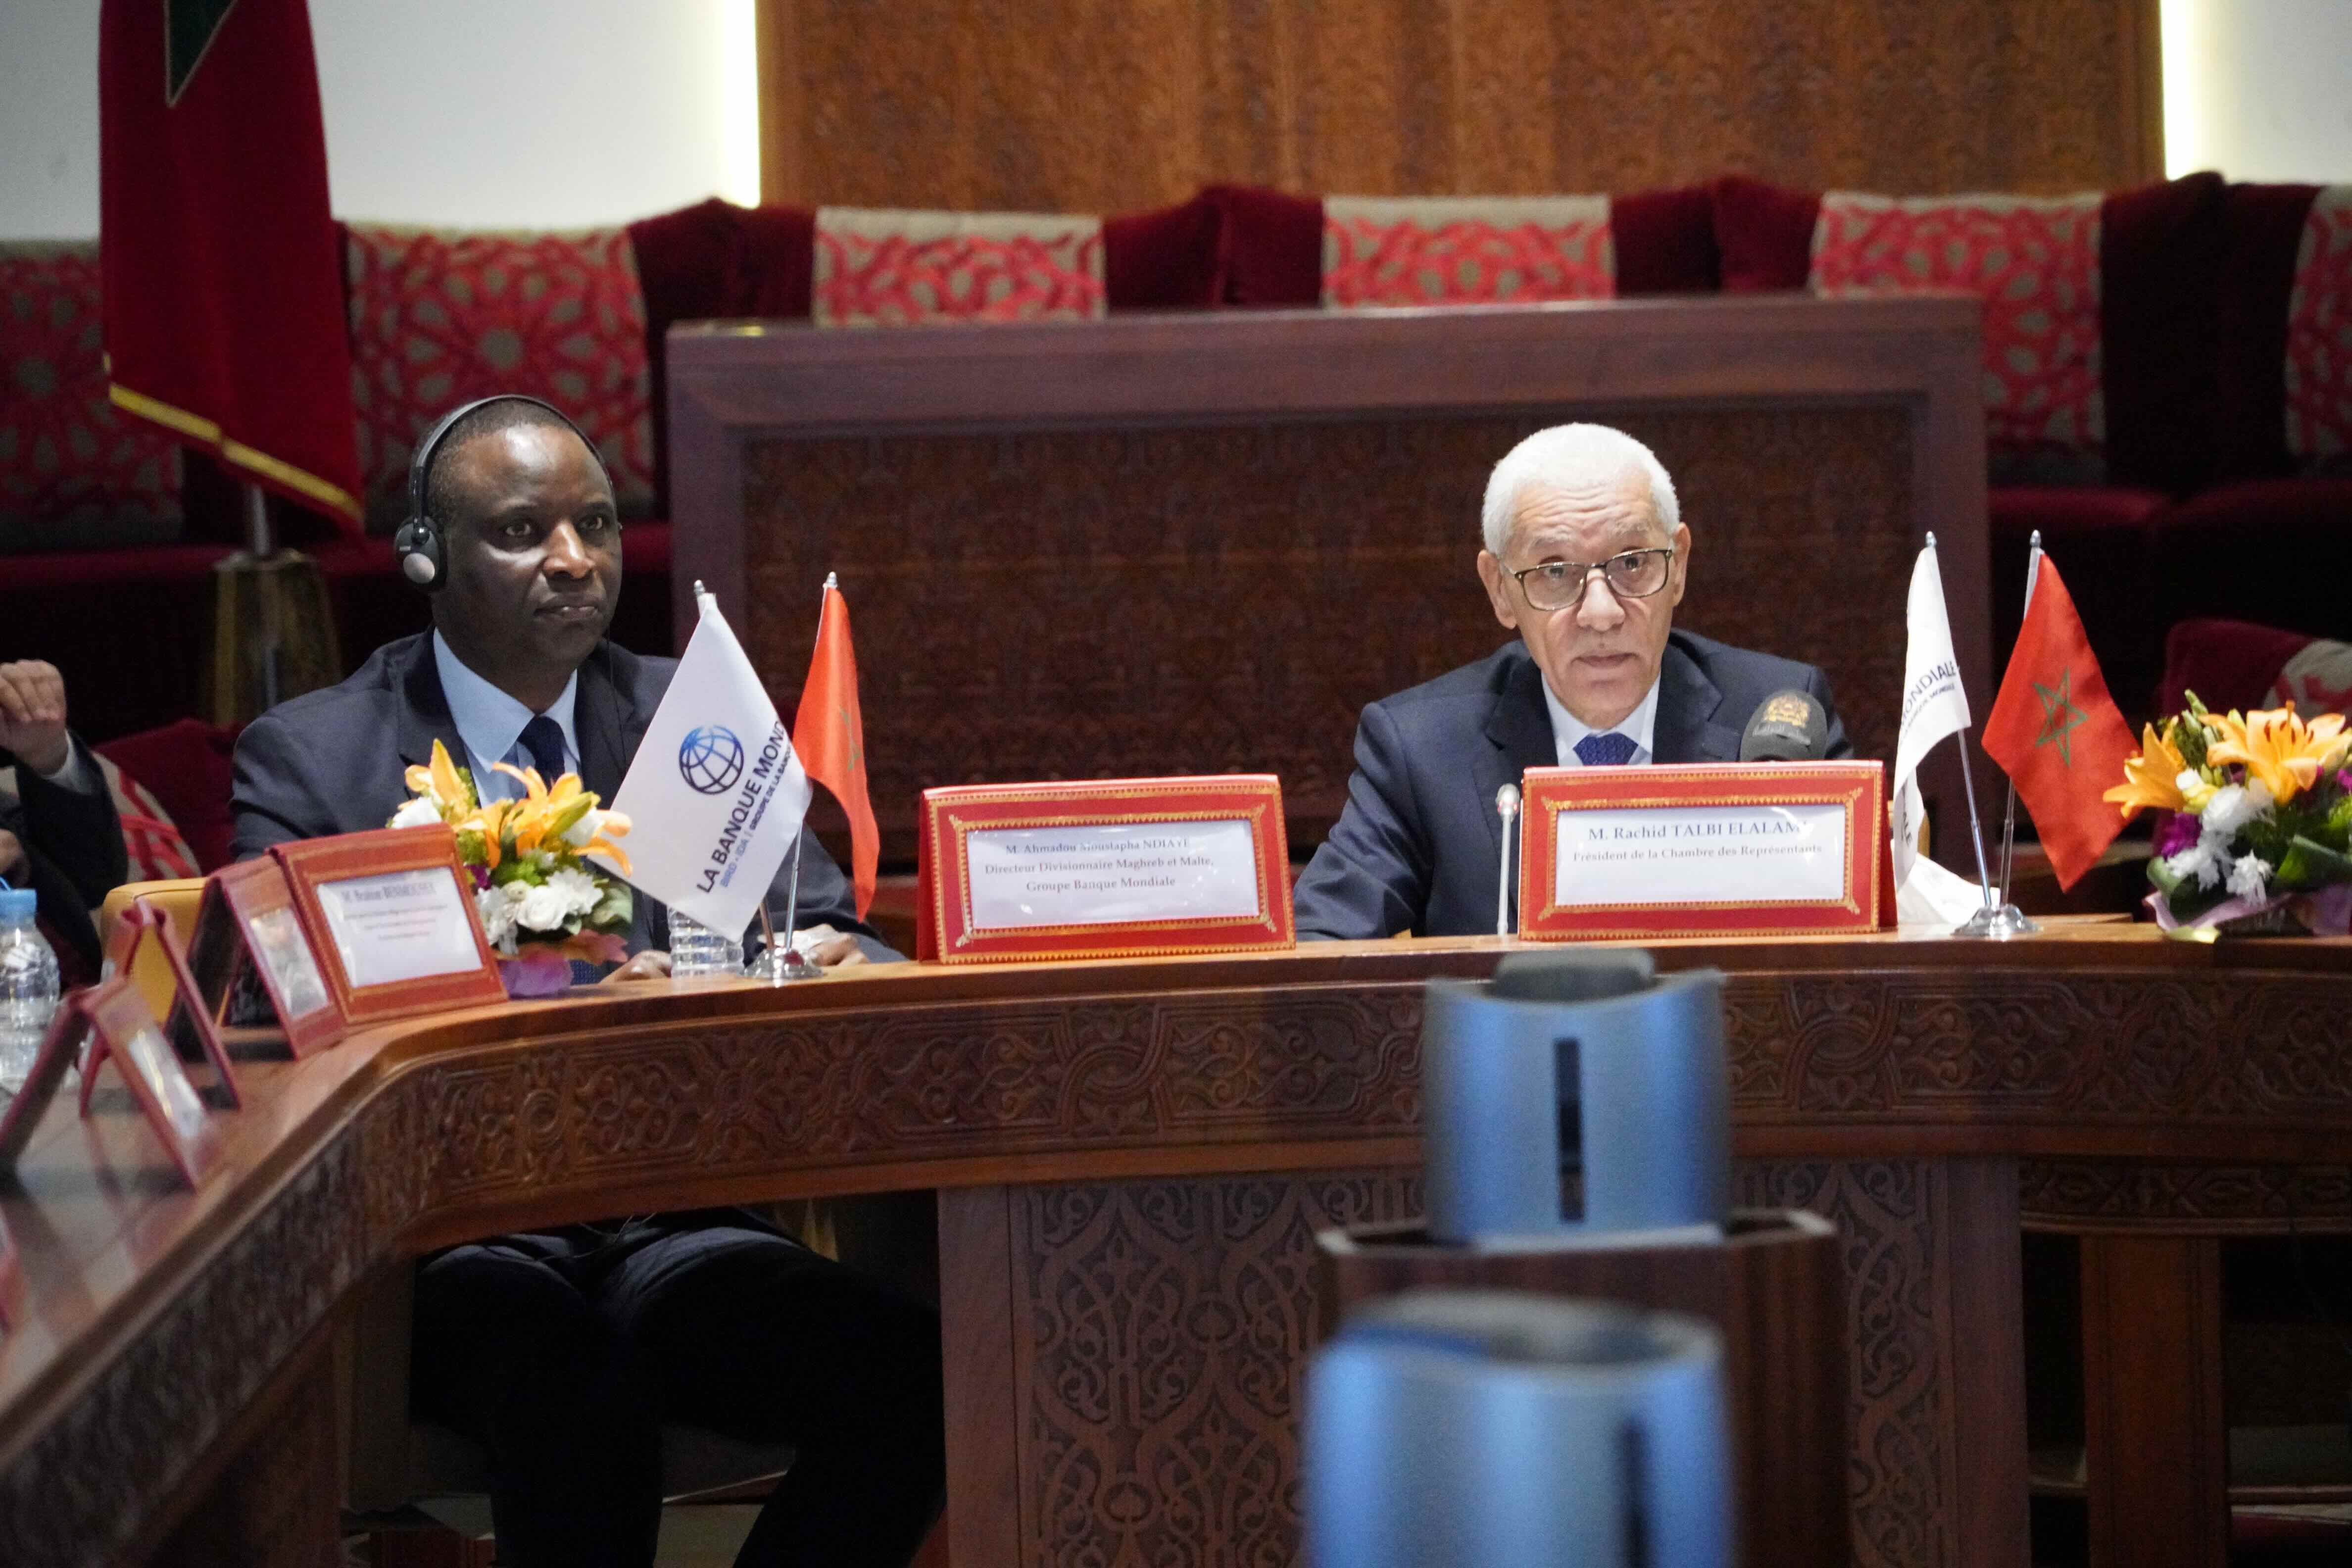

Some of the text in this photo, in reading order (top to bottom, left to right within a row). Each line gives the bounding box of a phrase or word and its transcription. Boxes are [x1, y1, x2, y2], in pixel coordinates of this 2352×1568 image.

[772, 775, 782, 785] LA
[697, 869, 720, 893] LA
[711, 779, 762, 865] BANQUE
[1589, 821, 1807, 840] M. Rachid TALBI ELALAM
[1024, 843, 1076, 854] Ahmadou
[1631, 849, 1644, 860] de
[1648, 849, 1657, 859] la
[1662, 847, 1714, 859] Chambre
[1718, 846, 1736, 856] des
[1741, 844, 1822, 858] Représentants
[985, 855, 1214, 875] Directeur Divisionnaire Maghreb et Malte,
[1027, 875, 1176, 894] Groupe Banque Mondiale
